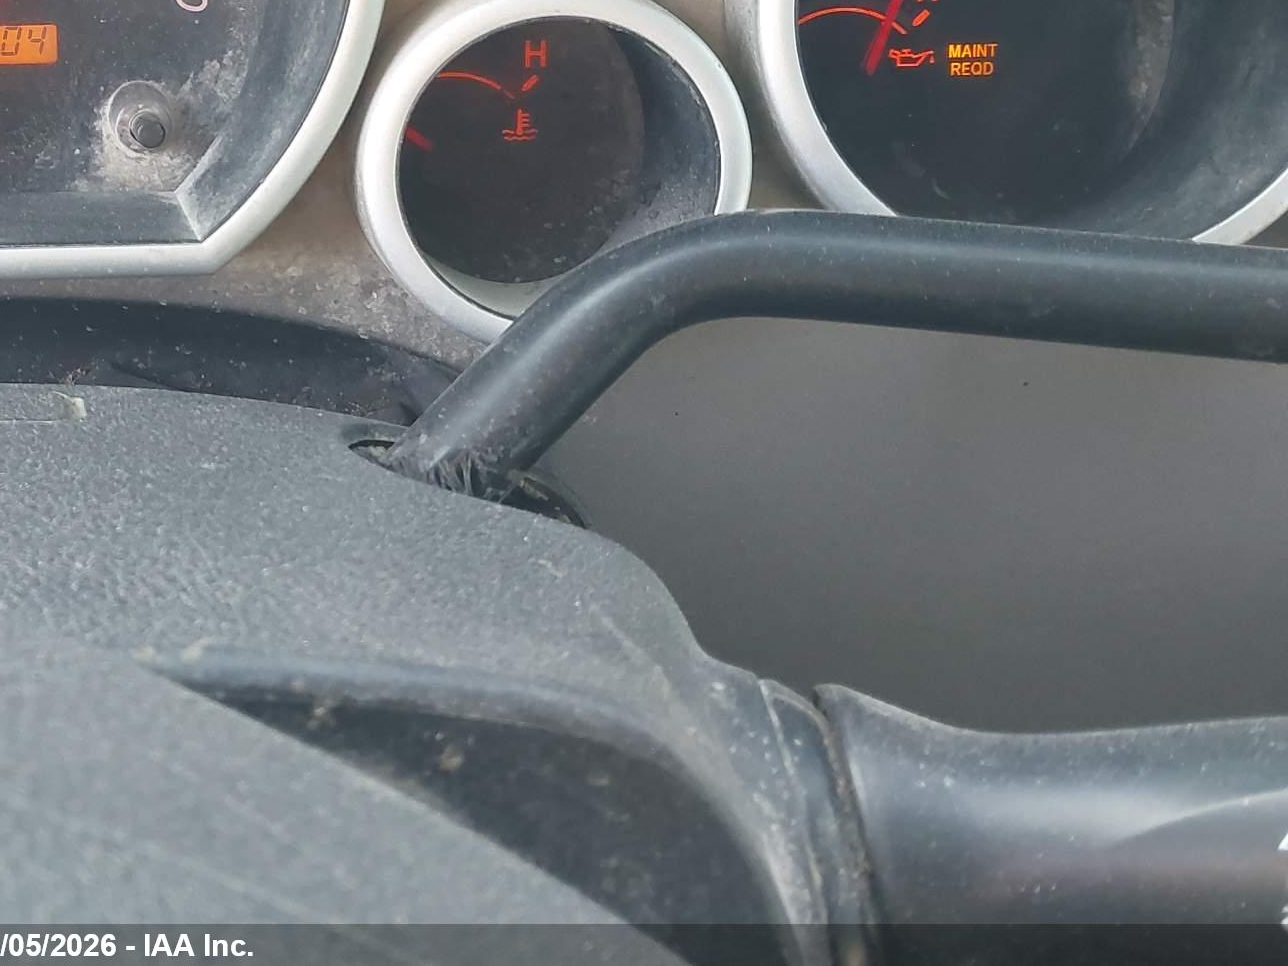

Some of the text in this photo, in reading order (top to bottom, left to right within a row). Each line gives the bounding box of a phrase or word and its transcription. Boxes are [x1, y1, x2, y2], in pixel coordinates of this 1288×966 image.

[524, 40, 547, 68] H
[948, 43, 999, 59] MAINT
[950, 61, 994, 77] REQD
